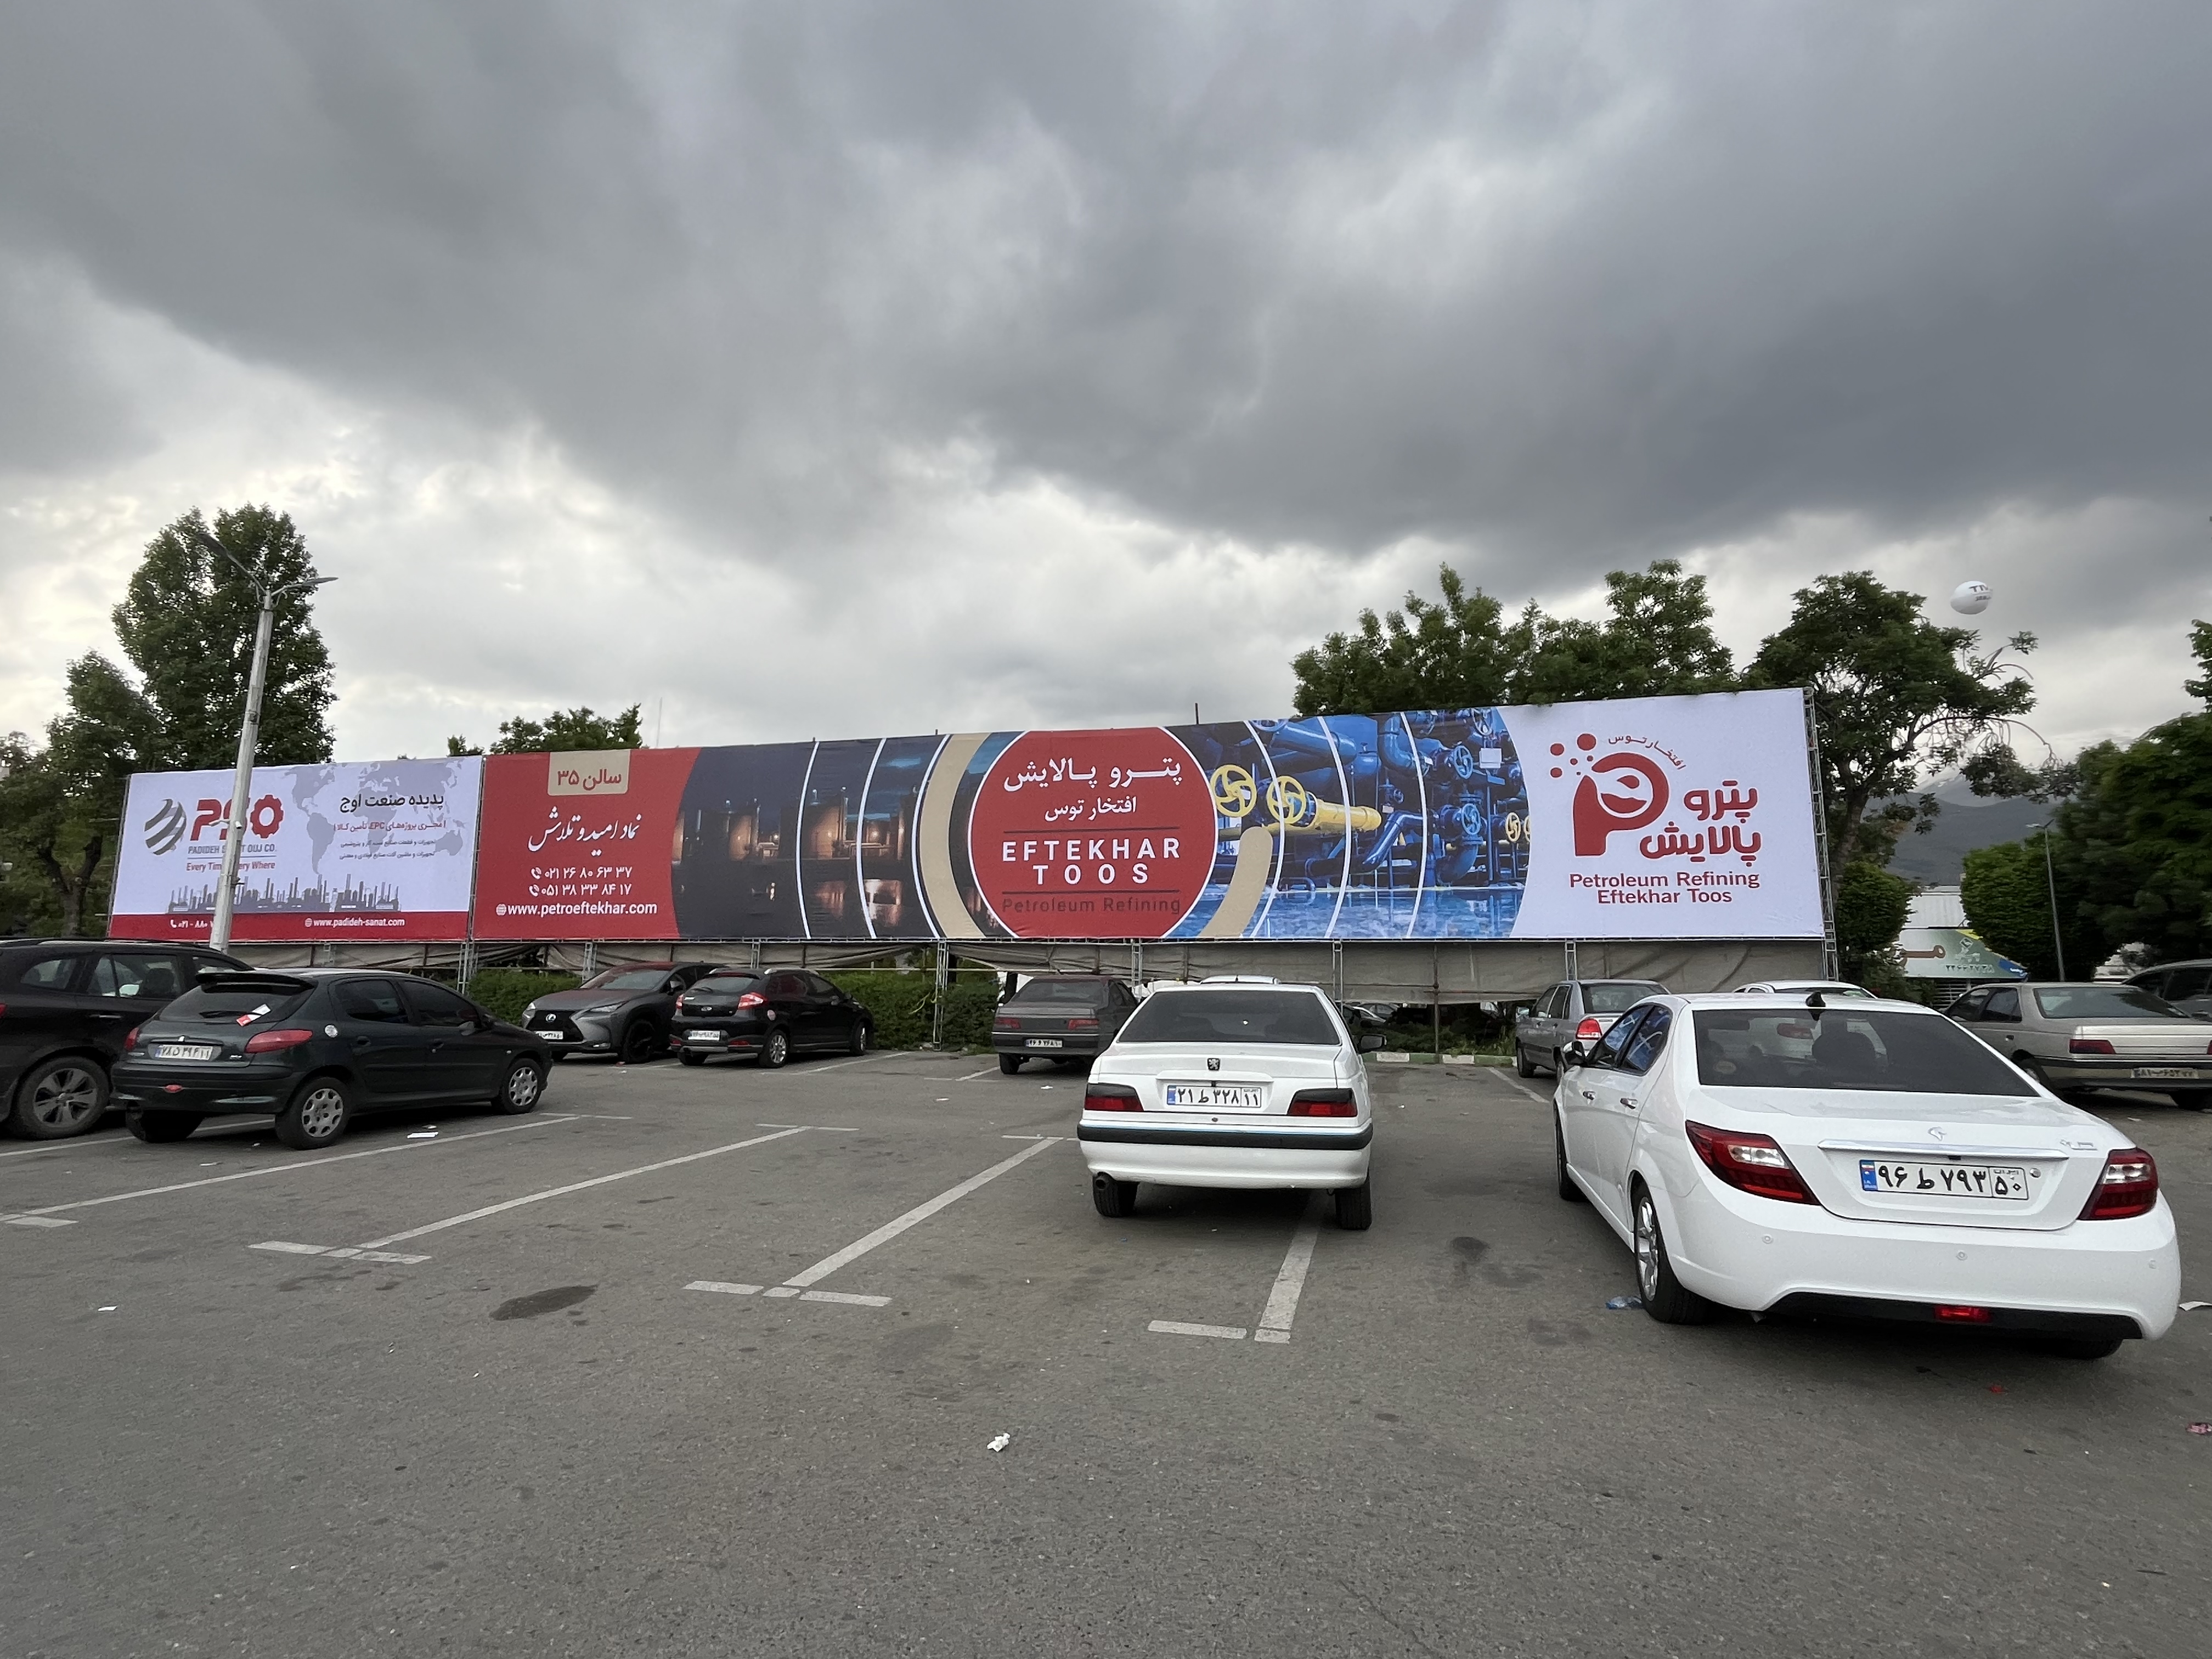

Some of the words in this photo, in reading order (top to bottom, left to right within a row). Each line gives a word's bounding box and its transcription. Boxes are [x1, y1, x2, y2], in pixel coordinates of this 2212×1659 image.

[1608, 734, 1647, 745] توس
[1646, 741, 1686, 770] افتخار
[557, 770, 579, 786] ۳۵
[583, 769, 622, 791] سالن
[1003, 757, 1097, 792] پالایش
[1109, 757, 1182, 788] پترو
[340, 794, 362, 813] اوج
[365, 794, 405, 807] صنعت
[409, 794, 444, 811] پدیده
[1088, 796, 1137, 821] افتخار
[1684, 780, 1758, 823] پترو
[1045, 800, 1084, 822] توس
[528, 806, 581, 851] تلاش
[577, 827, 586, 841] و
[619, 814, 642, 840] نماد
[585, 820, 619, 856] امید
[1640, 821, 1762, 867] پالایش
[188, 845, 219, 854] PADIDEH
[247, 844, 263, 853] OUJ
[1002, 837, 1180, 862] EFTEKHAR
[186, 862, 206, 873] Every
[208, 862, 222, 871] Tim
[251, 861, 275, 870] Where
[579, 867, 593, 878] ۸۰
[1033, 863, 1148, 884] TOOS
[1570, 873, 1668, 888] Petroleum
[1677, 871, 1760, 889] Refining
[1002, 898, 1095, 913] Petroleum
[1103, 896, 1180, 915] Refining
[1598, 889, 1680, 904] Eftekhar
[1688, 888, 1733, 903] Toos
[507, 901, 657, 917] www.petroeftekhar.com
[313, 917, 405, 928] www.padideh-sanat.com
[1177, 1088, 1193, 1103] ۲۱
[1213, 1089, 1239, 1104] ۳۲۸
[1244, 1093, 1259, 1106] ۱۱
[1878, 1165, 1908, 1189] ۹۶
[1917, 1167, 1935, 1189] ط
[1940, 1169, 1986, 1193] ۷۹۳
[1995, 1175, 2022, 1195] ۵۰
